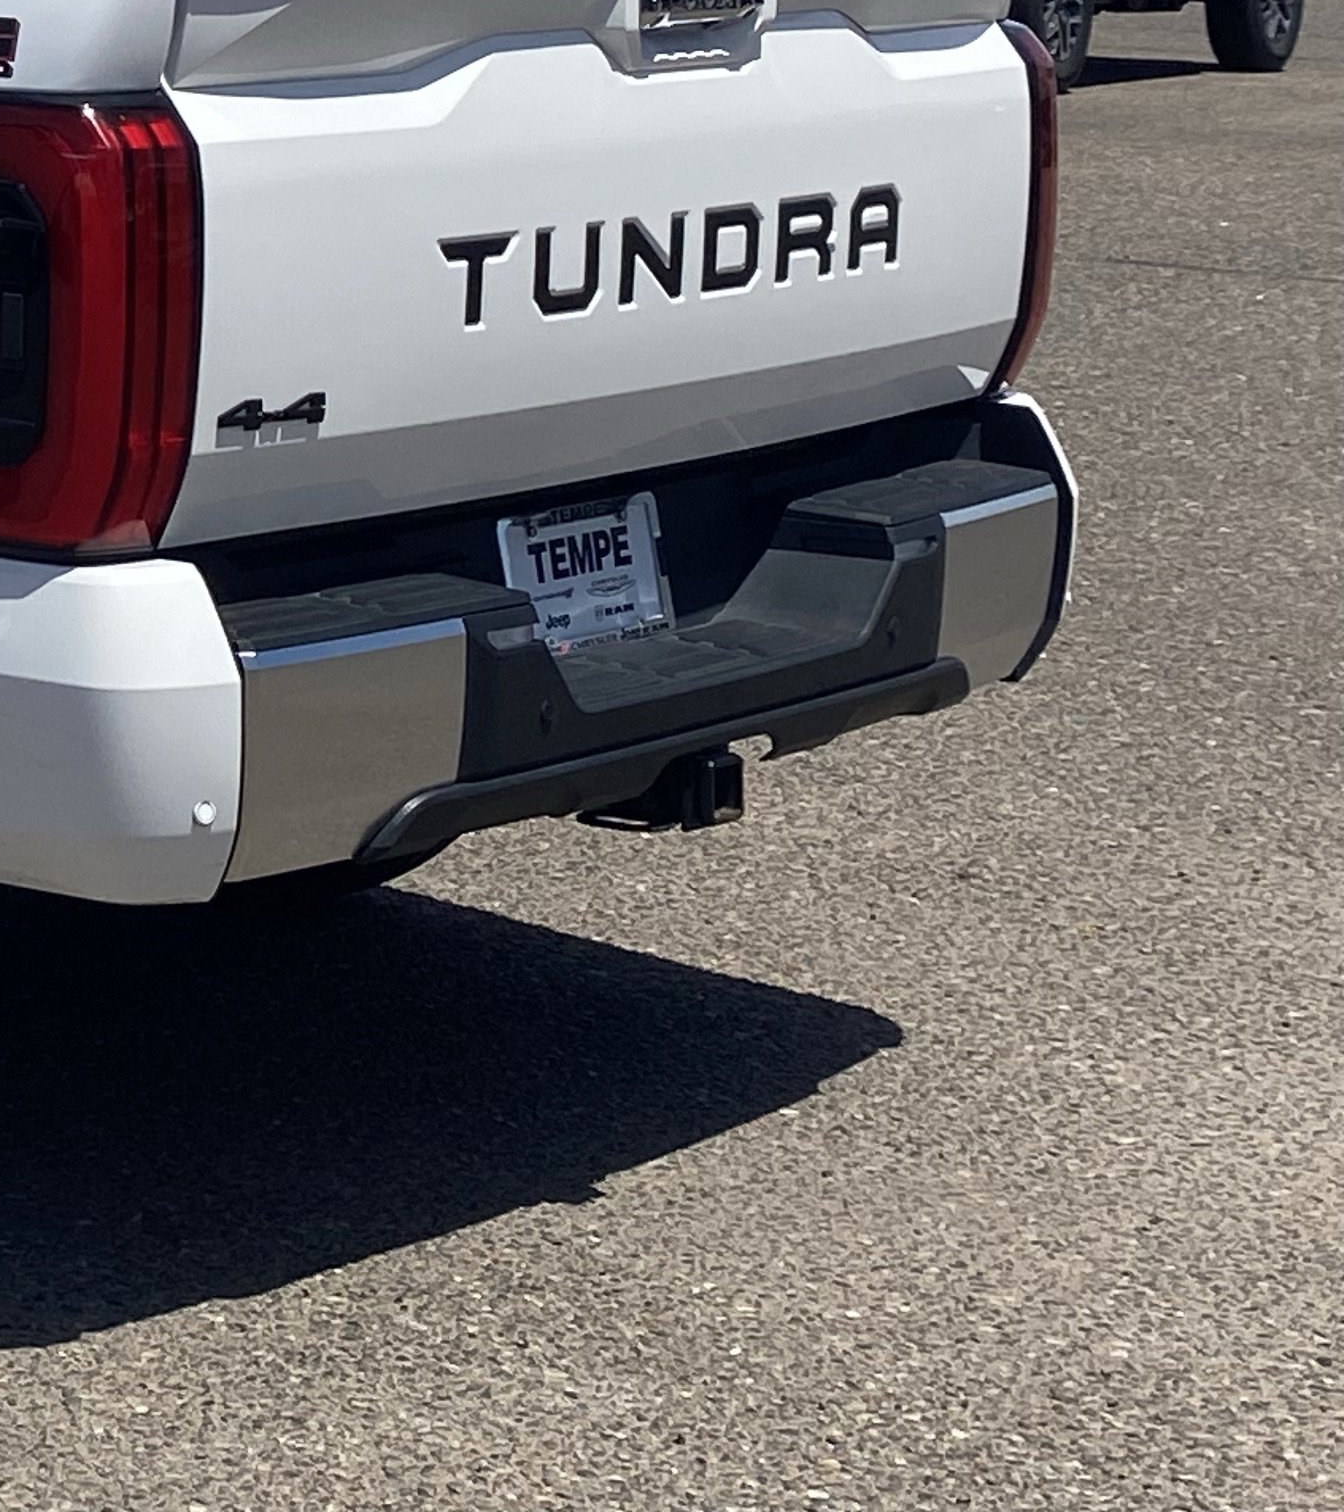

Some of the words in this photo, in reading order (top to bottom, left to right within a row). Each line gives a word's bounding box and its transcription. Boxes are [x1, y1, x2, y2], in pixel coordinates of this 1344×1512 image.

[437, 183, 902, 329] TUNDRA
[527, 525, 633, 584] TEMPE
[546, 614, 571, 630] Jeep
[605, 603, 635, 617] RAM
